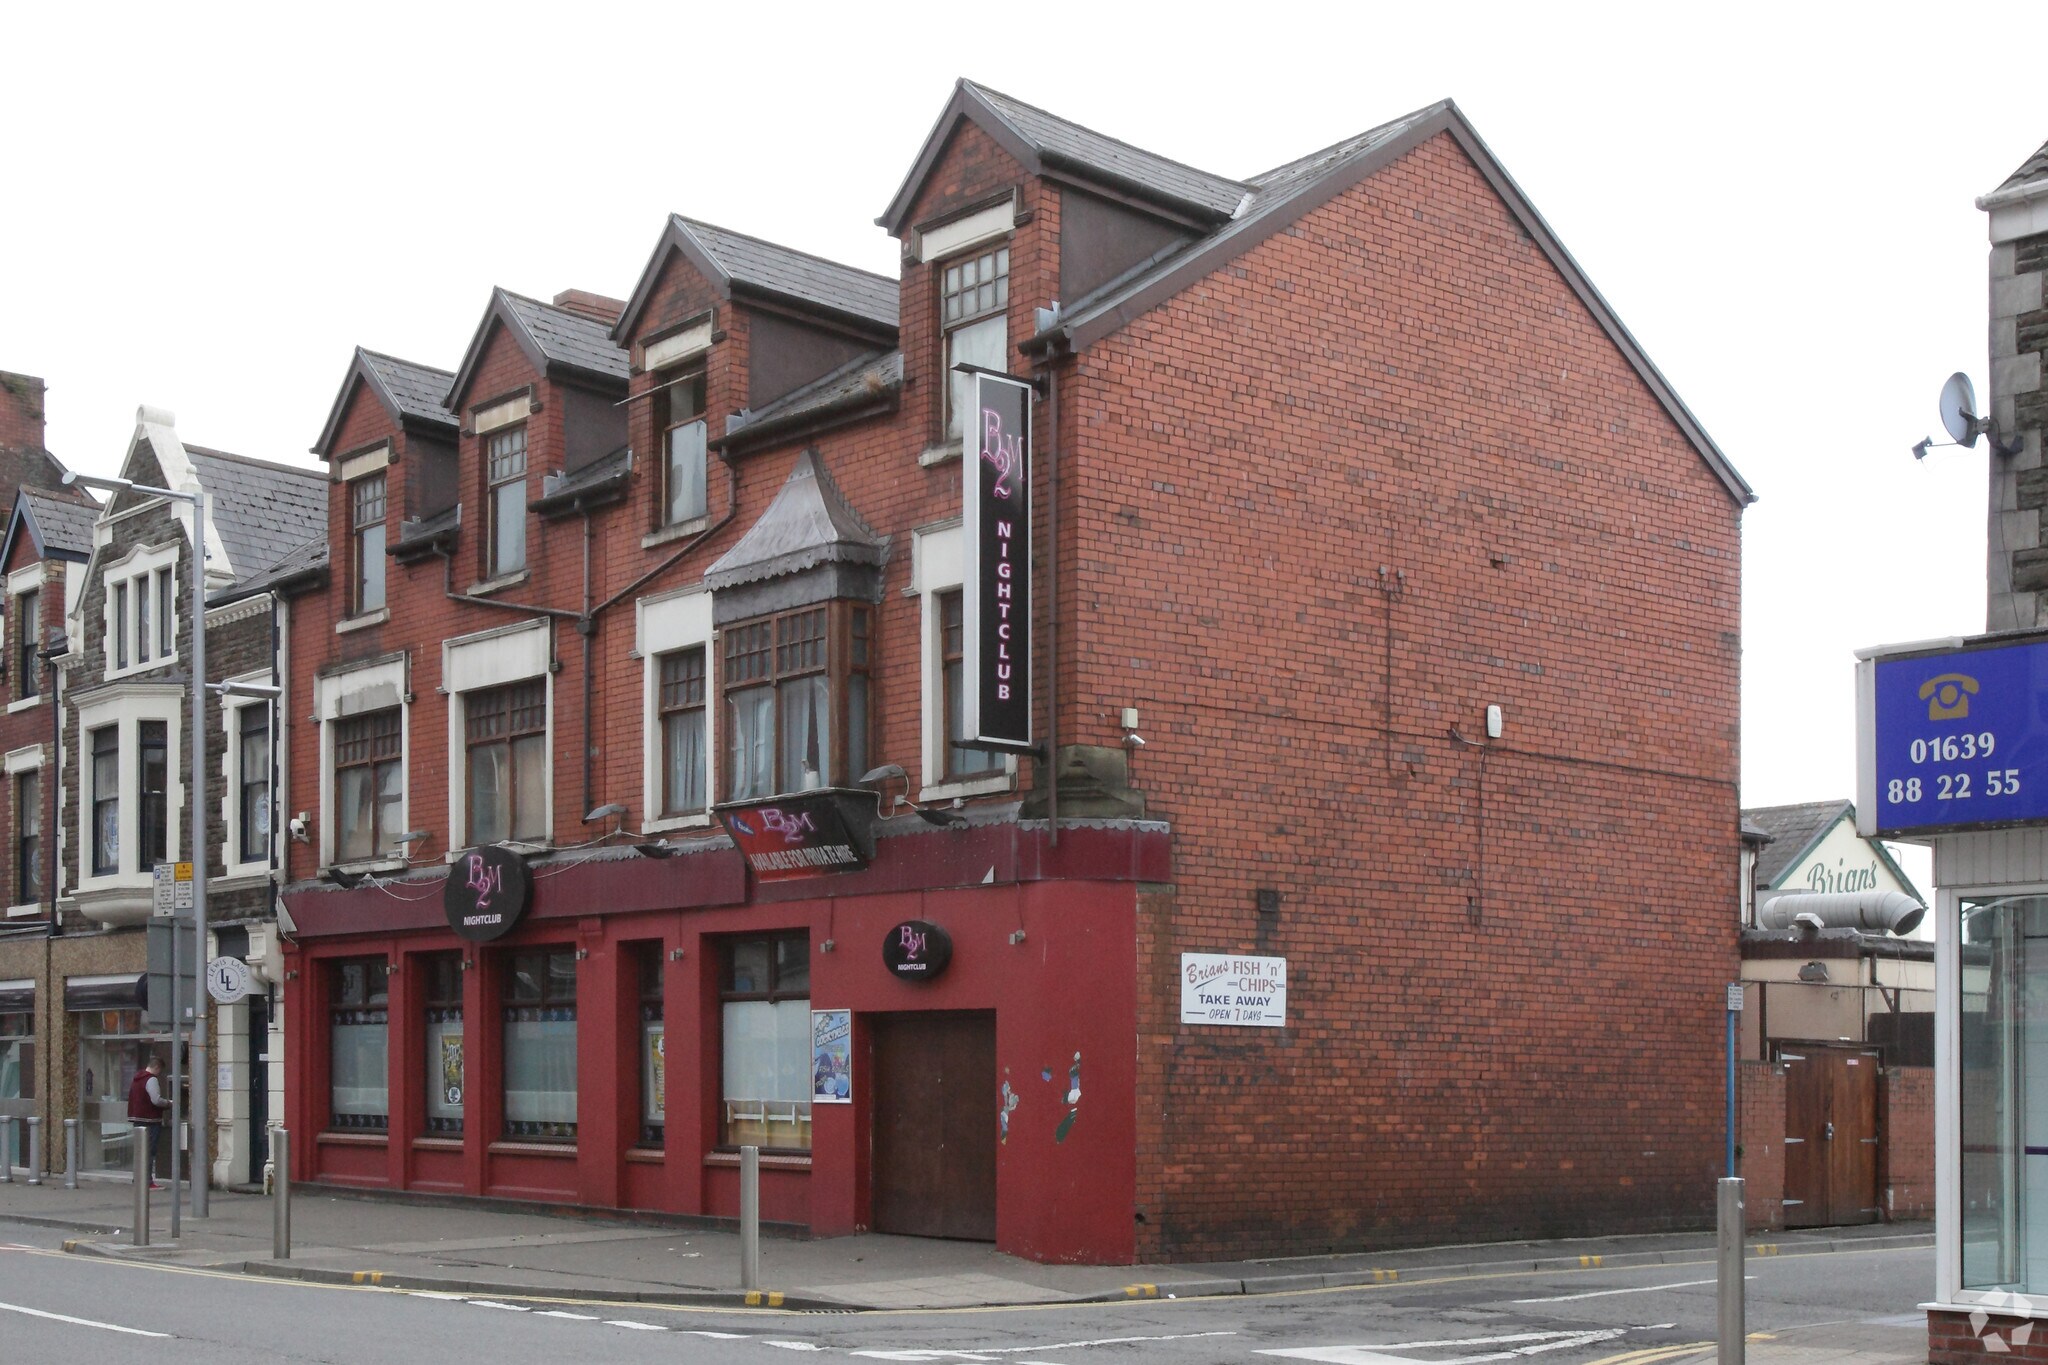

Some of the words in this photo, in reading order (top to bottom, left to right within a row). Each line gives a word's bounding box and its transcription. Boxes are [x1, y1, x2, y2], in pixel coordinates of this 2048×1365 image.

[997, 521, 1012, 700] NIGHTCLUB
[1910, 732, 1995, 764] 01639
[1887, 777, 1922, 804] 88
[1936, 773, 1971, 800] 22
[1985, 769, 2020, 796] 55
[750, 851, 793, 872] AVAILABLE
[786, 849, 809, 868] FOR
[803, 845, 839, 866] PRIVATE
[833, 844, 858, 864] HIRE
[1807, 858, 1877, 893] Brian's
[463, 913, 502, 926] NIGHTCLUB
[208, 959, 227, 977] LEWIS
[231, 960, 247, 978] LADD
[897, 963, 927, 971] NIGHTCLUB
[1186, 961, 1229, 984] Brians
[1233, 961, 1260, 975] FISH
[1239, 978, 1276, 993] CHIPS
[1199, 994, 1230, 1005] TAKE
[1235, 996, 1271, 1006] AWAY
[1209, 1008, 1231, 1019] OPEN
[1235, 1008, 1240, 1021] 7
[1243, 1010, 1261, 1021] DAYS
